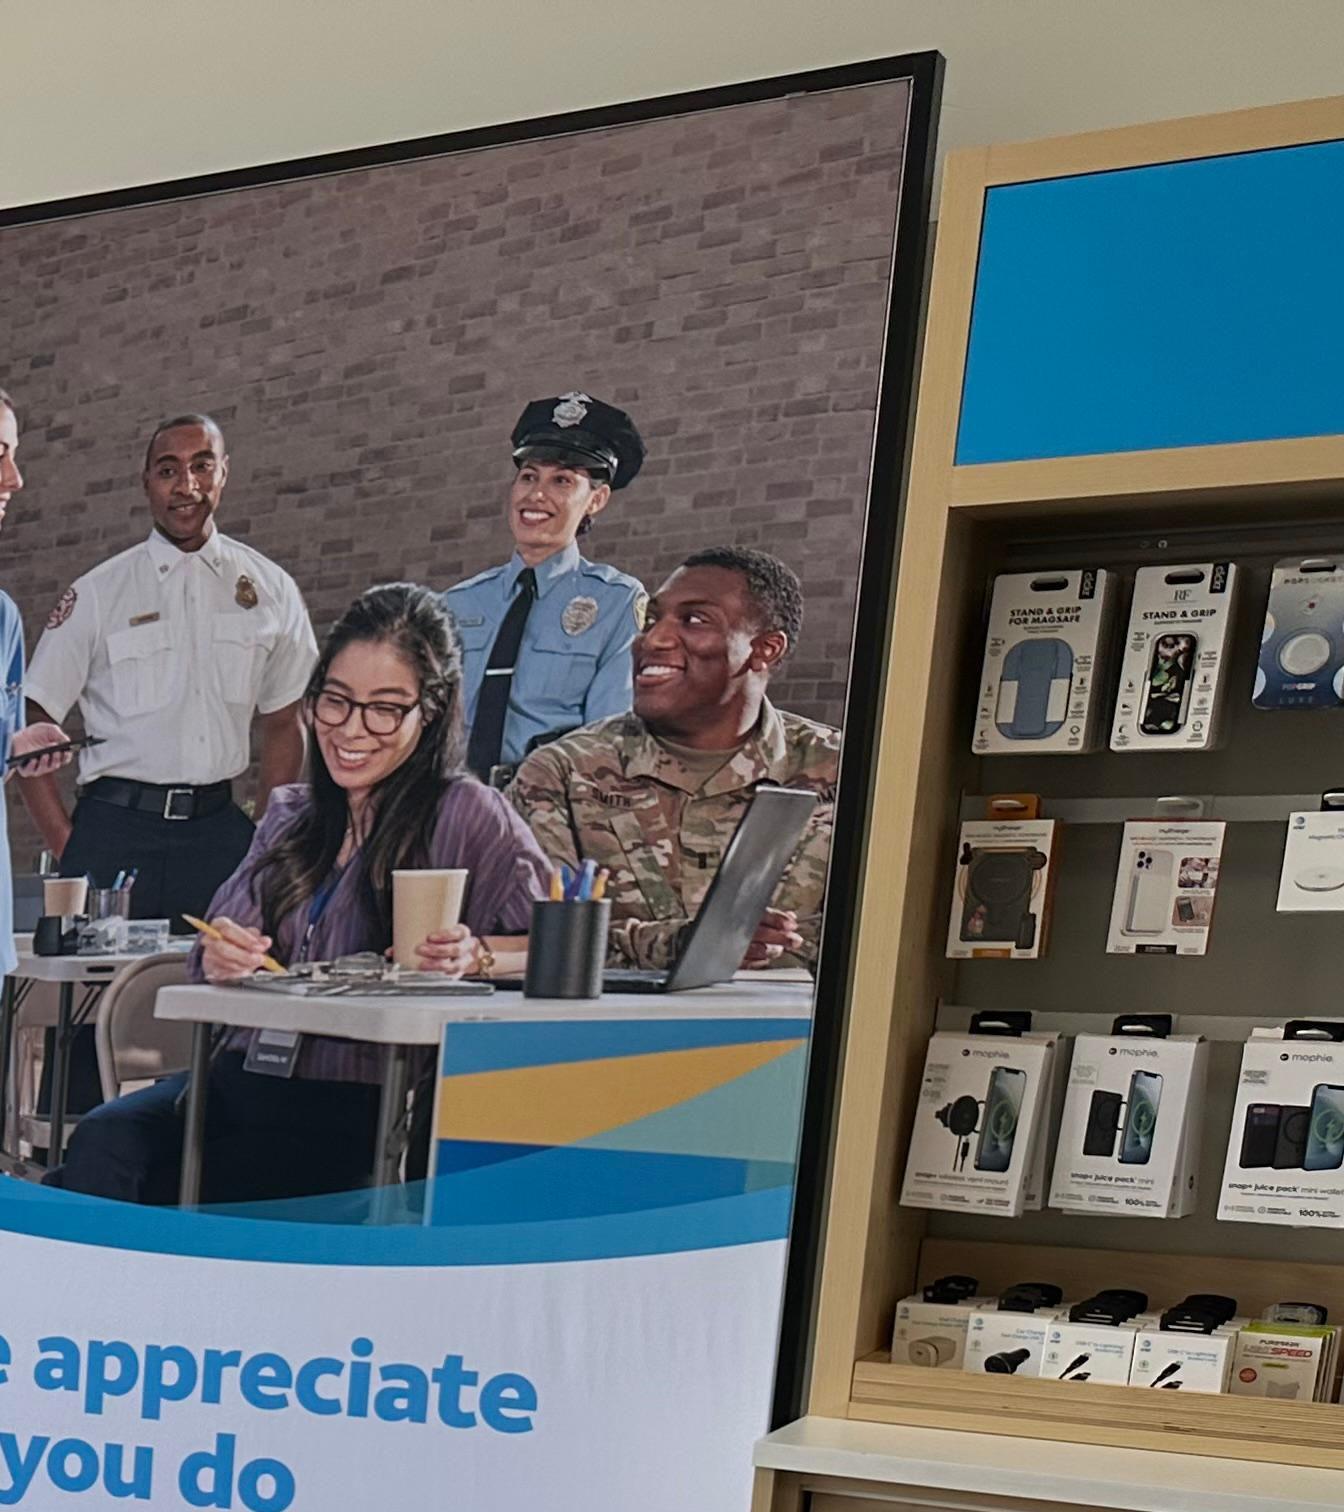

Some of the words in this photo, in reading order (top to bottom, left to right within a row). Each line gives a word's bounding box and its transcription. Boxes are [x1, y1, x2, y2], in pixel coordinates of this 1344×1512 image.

[1010, 607, 1046, 617] STAND
[1046, 607, 1054, 616] &
[1055, 606, 1082, 615] GRIP
[1142, 610, 1177, 620] STAND
[1179, 611, 1189, 619] &
[1190, 608, 1217, 618] GRIP
[1009, 617, 1030, 626] FOR
[1031, 614, 1081, 625] MAGSAFE
[591, 786, 632, 808] SMITH
[972, 1048, 1010, 1059] mophie
[1119, 1047, 1159, 1058] mophie
[1292, 1053, 1332, 1063] mophie
[1254, 1181, 1275, 1192] juice
[1276, 1184, 1298, 1194] pack
[33, 1335, 539, 1435] appreciate
